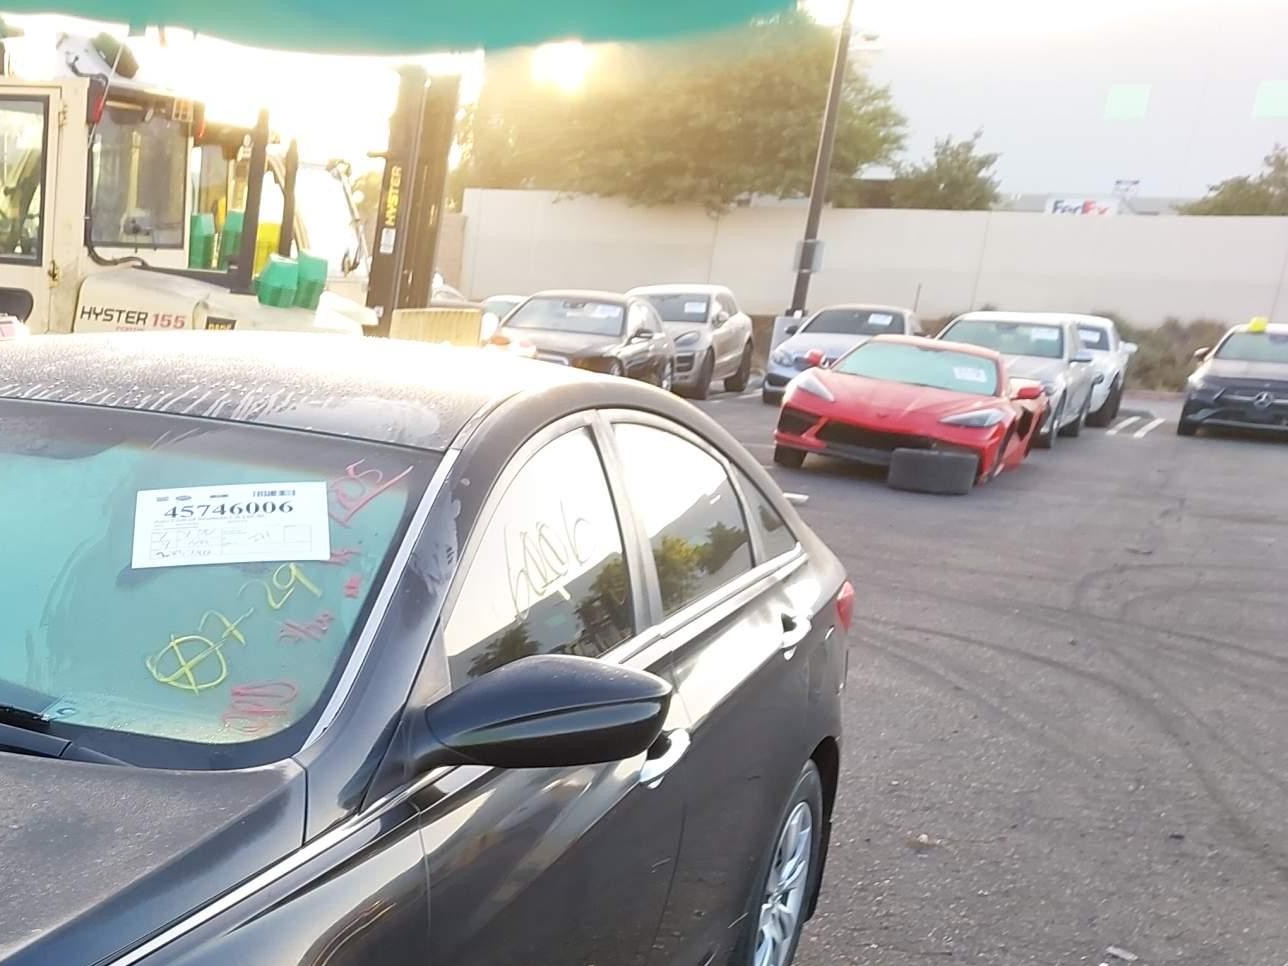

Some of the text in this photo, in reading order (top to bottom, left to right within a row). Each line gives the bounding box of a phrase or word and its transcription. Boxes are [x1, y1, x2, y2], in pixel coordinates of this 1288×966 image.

[384, 165, 403, 227] HYSTER
[80, 305, 149, 326] HYSTER
[151, 312, 186, 330] 155
[163, 500, 294, 519] 45746006
